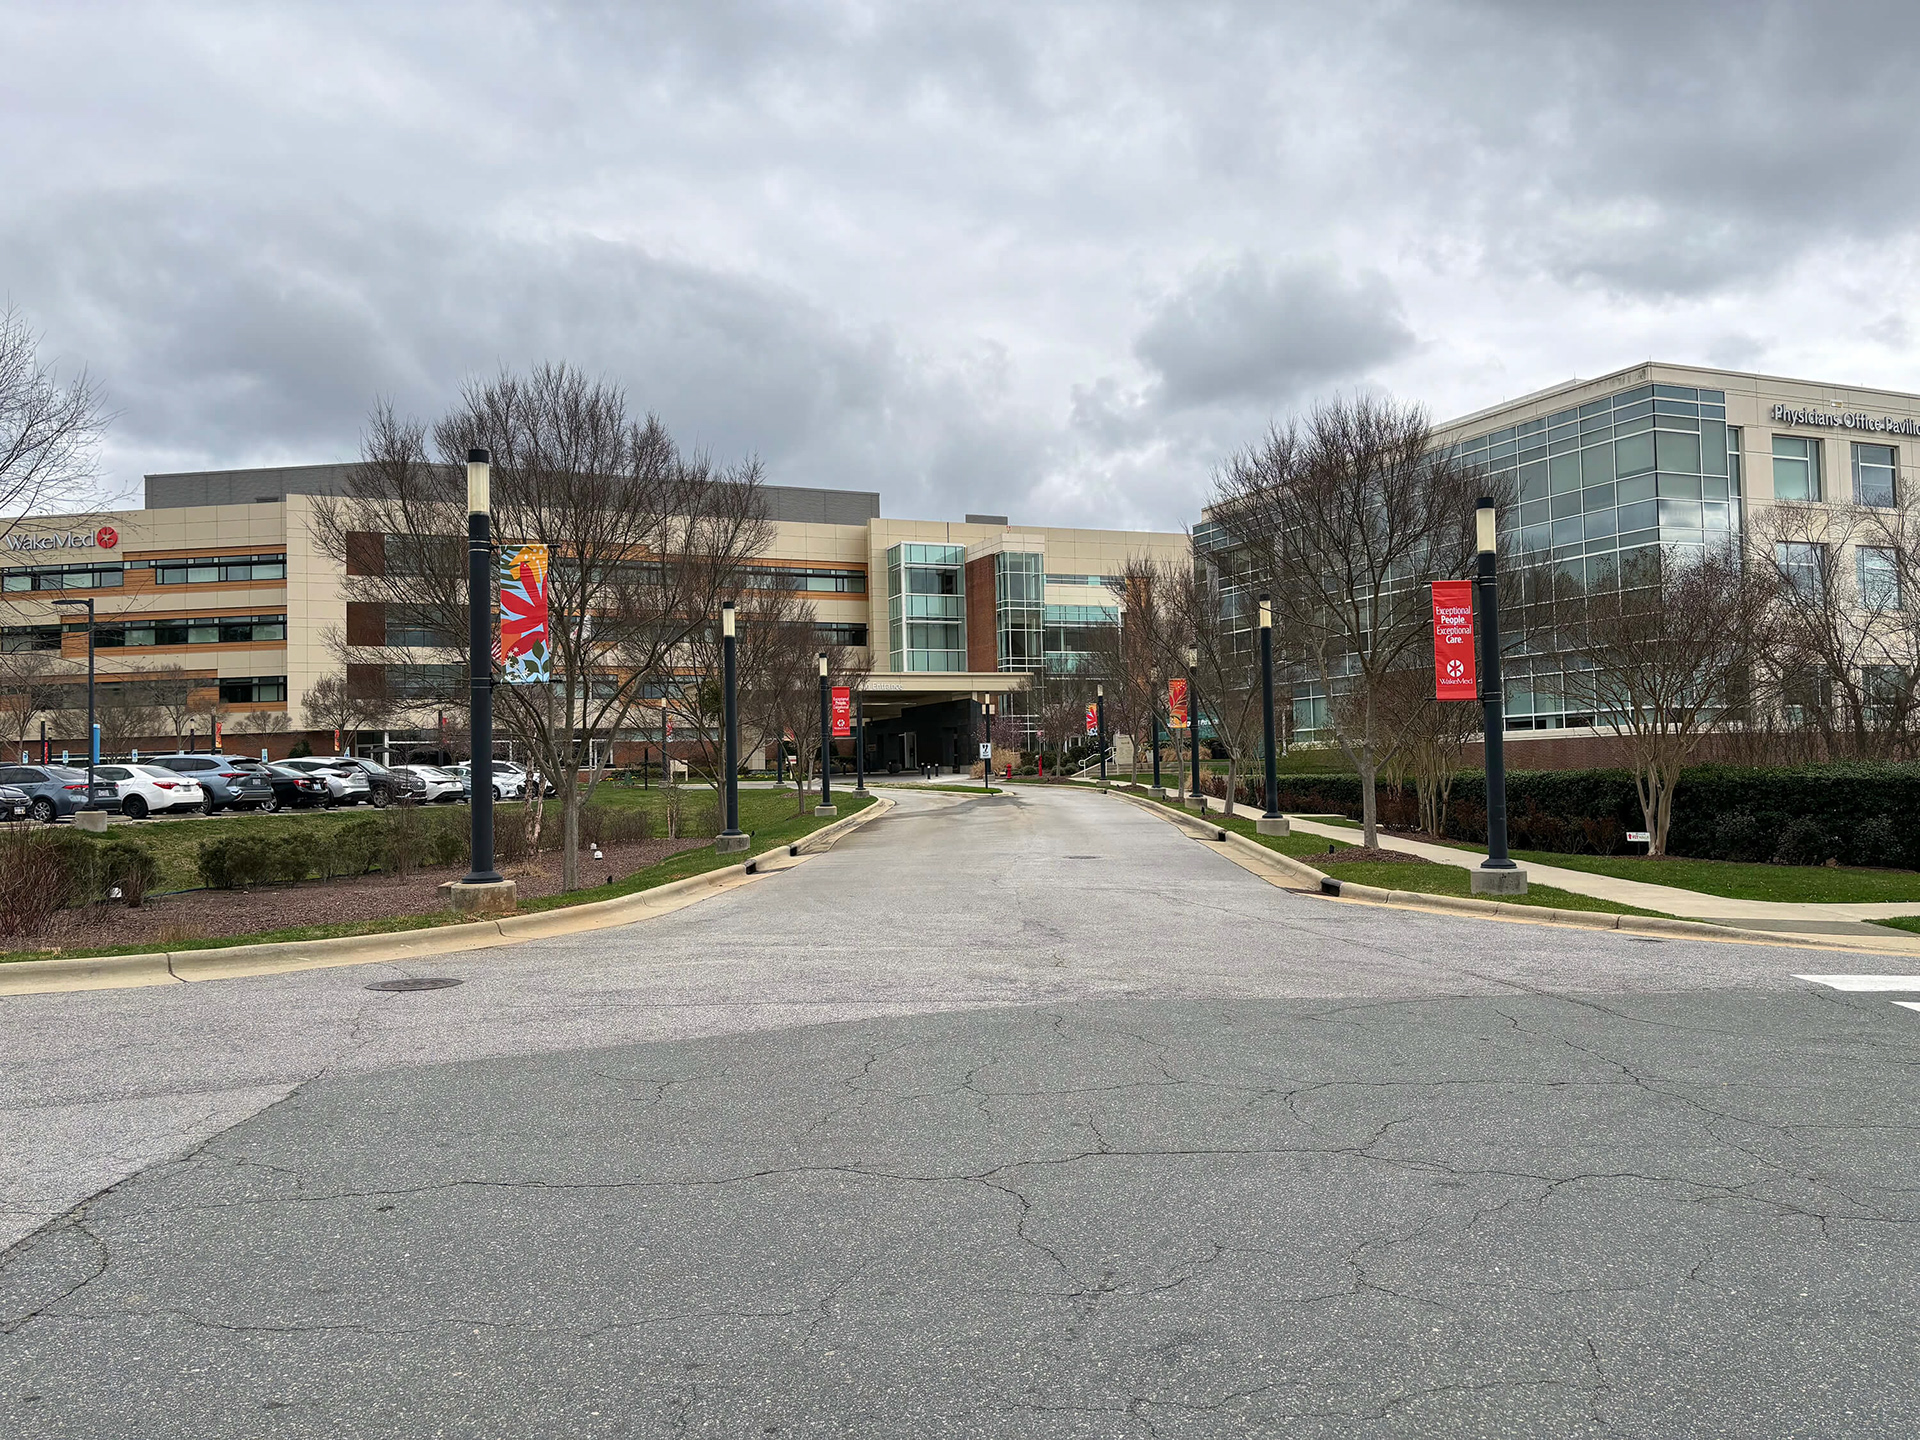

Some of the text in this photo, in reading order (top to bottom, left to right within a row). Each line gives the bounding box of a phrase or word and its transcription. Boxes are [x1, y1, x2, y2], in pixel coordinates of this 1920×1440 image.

[1774, 404, 1839, 427] Physicians
[1843, 412, 1881, 430] Office
[6, 530, 95, 551] WakeMed
[1436, 605, 1471, 617] Exceptional
[1436, 624, 1472, 636] Exceptional
[1445, 635, 1464, 644] Care.
[1439, 677, 1473, 685] WakeMed
